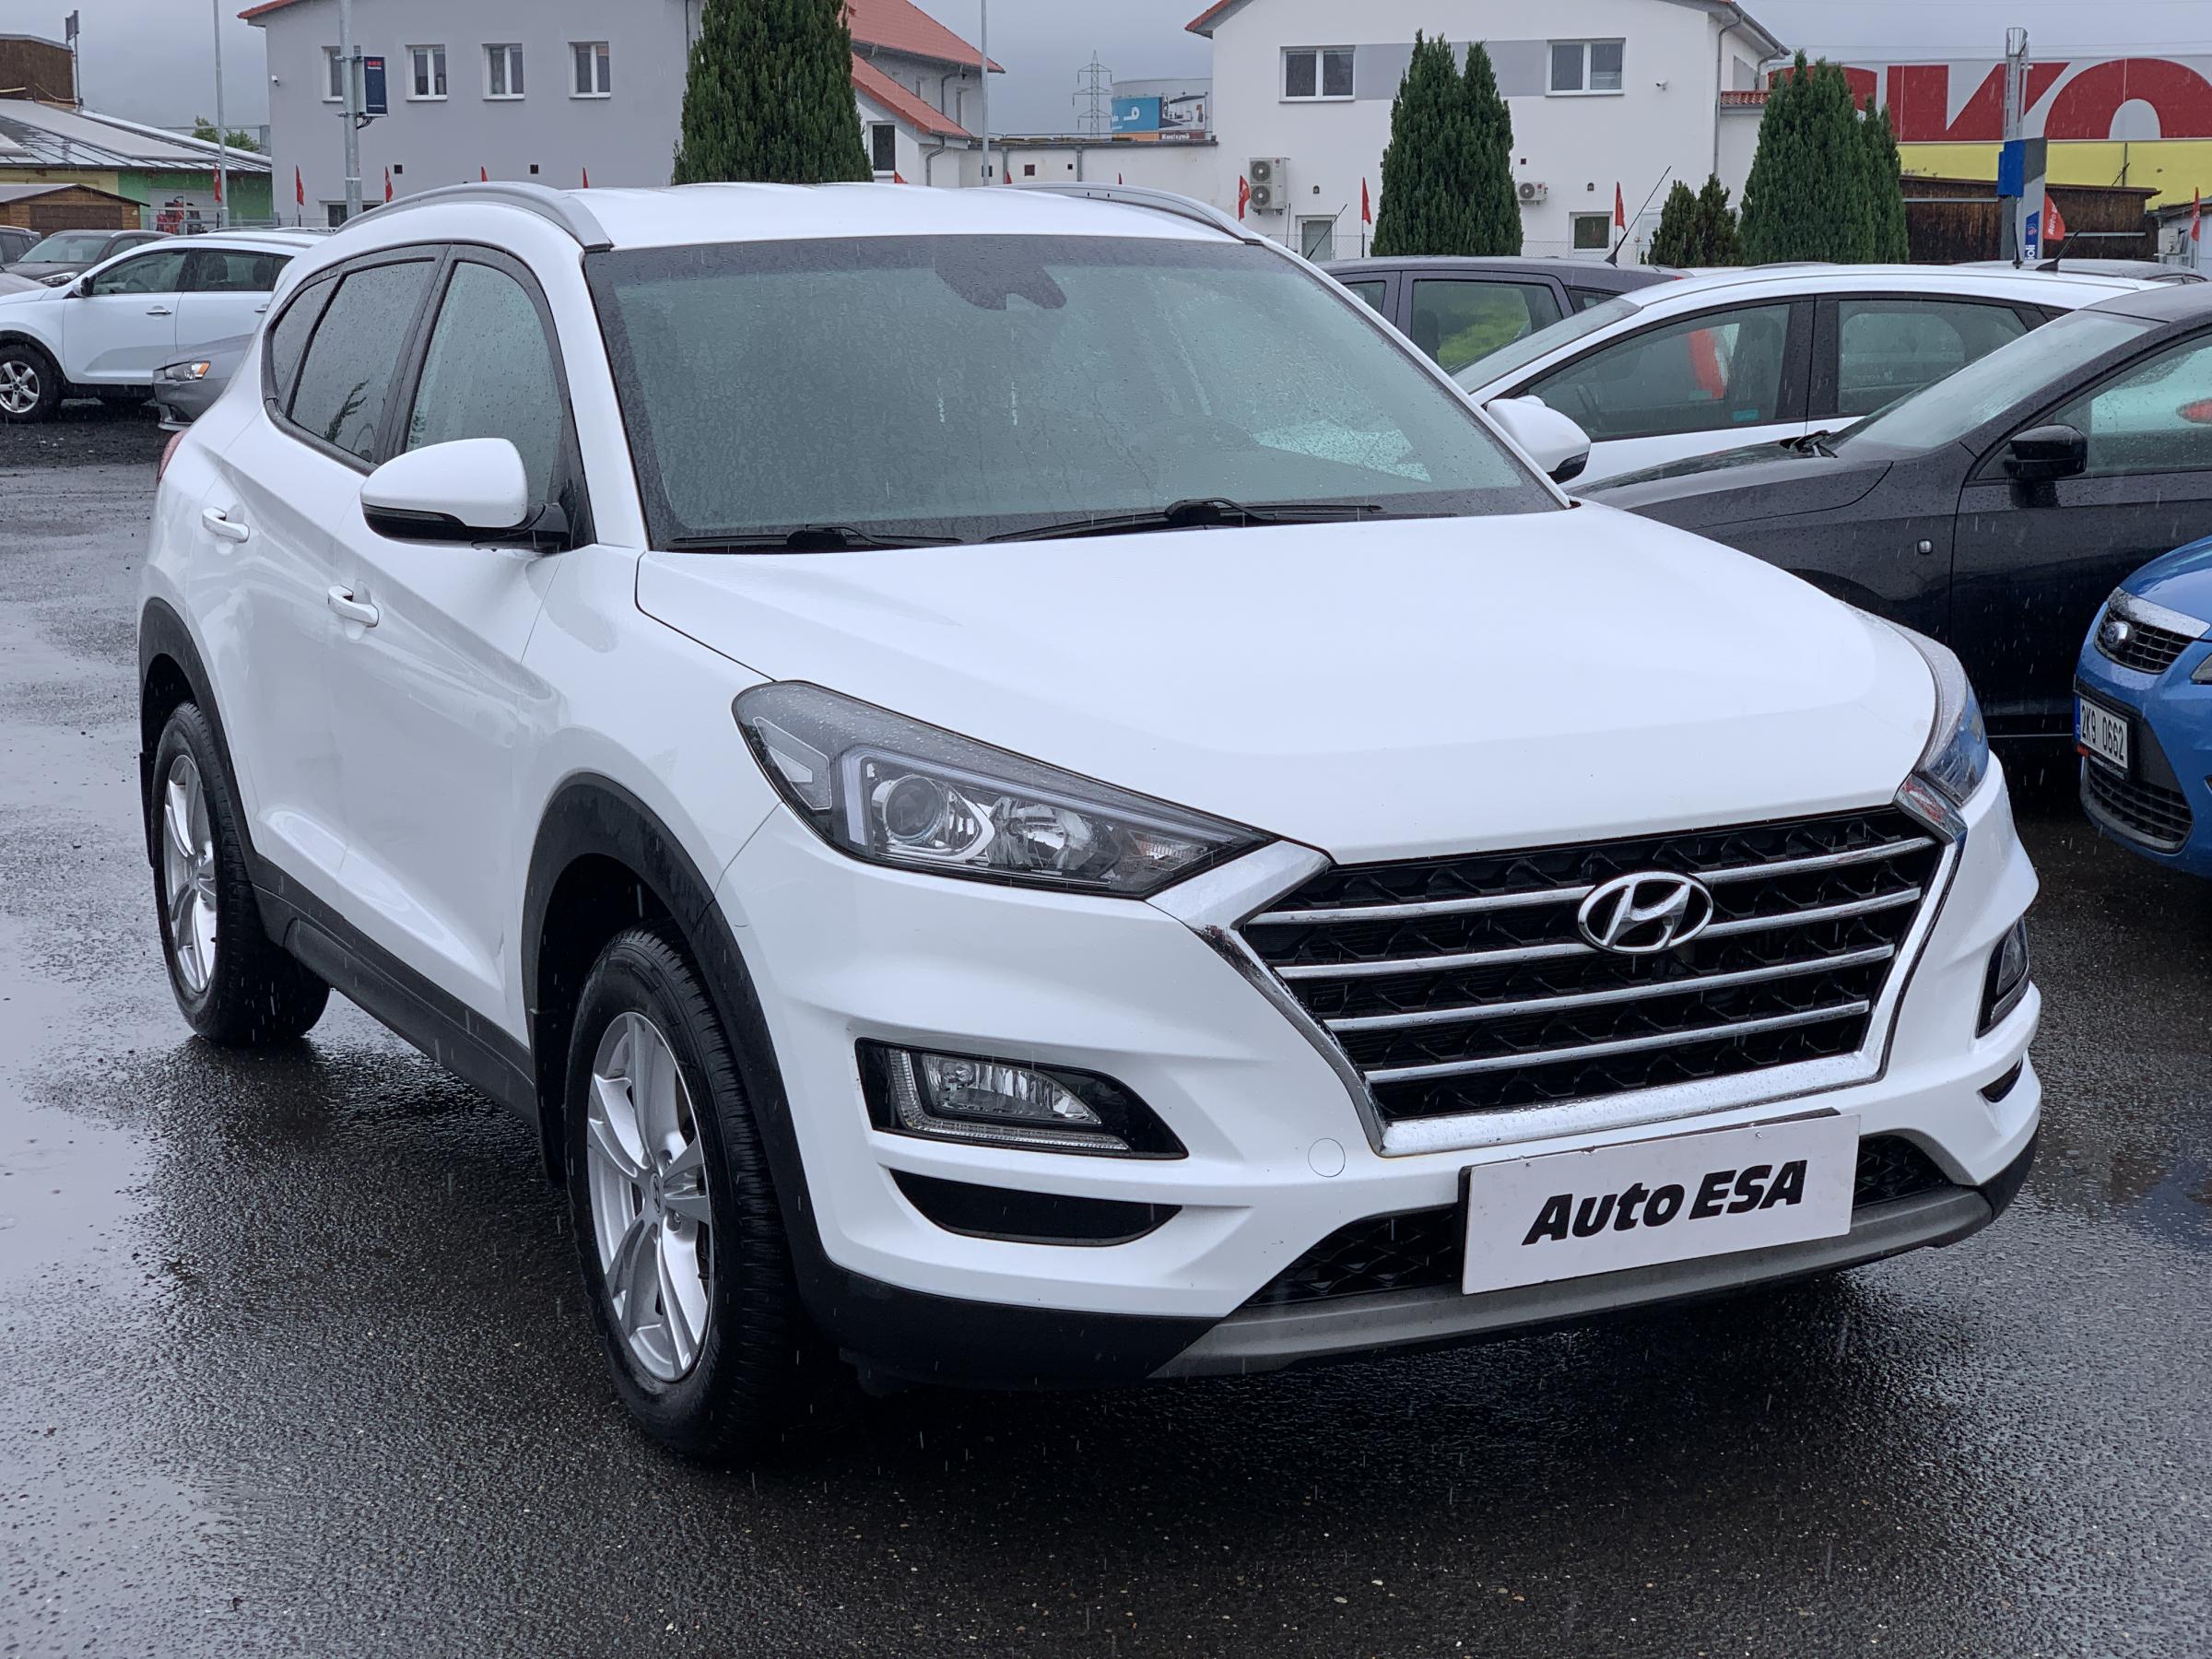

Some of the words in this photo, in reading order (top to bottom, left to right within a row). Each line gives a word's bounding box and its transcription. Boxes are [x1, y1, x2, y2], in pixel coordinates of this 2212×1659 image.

[2082, 704, 2097, 744] 2K9
[2102, 716, 2124, 761] 0662
[1521, 1182, 1685, 1245] Auto
[1688, 1159, 1807, 1220] ESA
